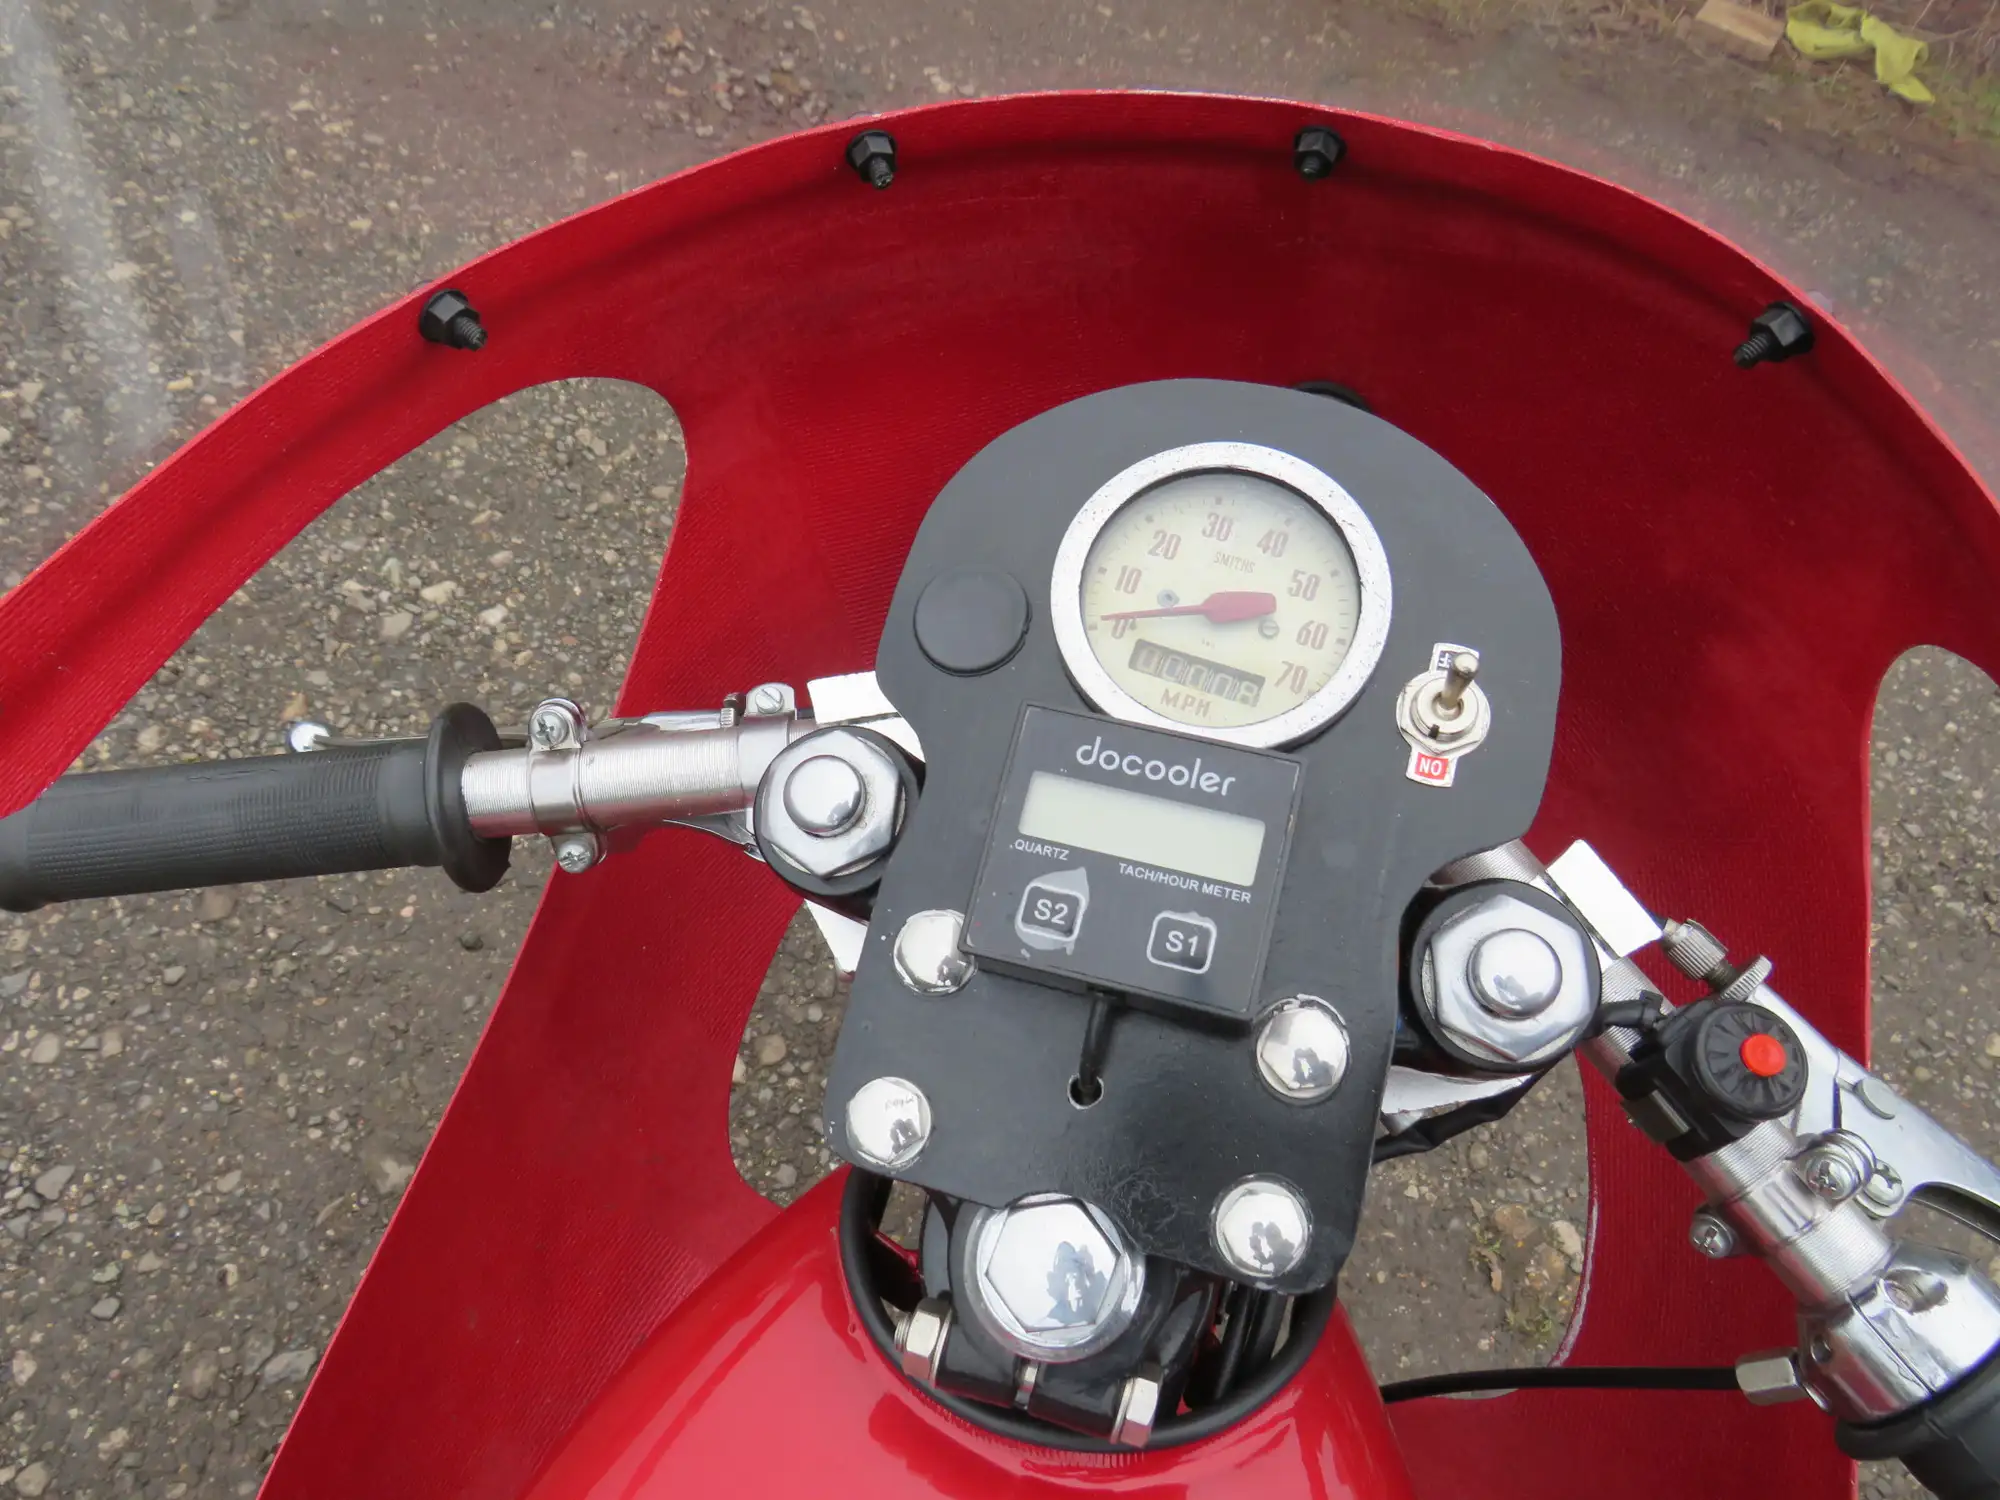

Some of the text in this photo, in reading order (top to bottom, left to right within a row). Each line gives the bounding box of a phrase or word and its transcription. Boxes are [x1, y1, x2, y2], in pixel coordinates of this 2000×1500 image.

[1202, 513, 1233, 541] 30
[1148, 530, 1181, 560] 20
[1257, 530, 1289, 558] 40
[1213, 551, 1256, 574] SMITHS
[1114, 565, 1142, 594] 10
[1288, 569, 1321, 601] 50
[1297, 620, 1329, 650] 60
[1274, 661, 1308, 693] 70
[1160, 688, 1212, 718] MPH
[1075, 736, 1236, 796] docooler
[1014, 838, 1070, 861] QUARTZ
[1118, 863, 1252, 904] TACH/HOUR METER
[1033, 897, 1069, 925] S2
[1165, 931, 1200, 957] S1
